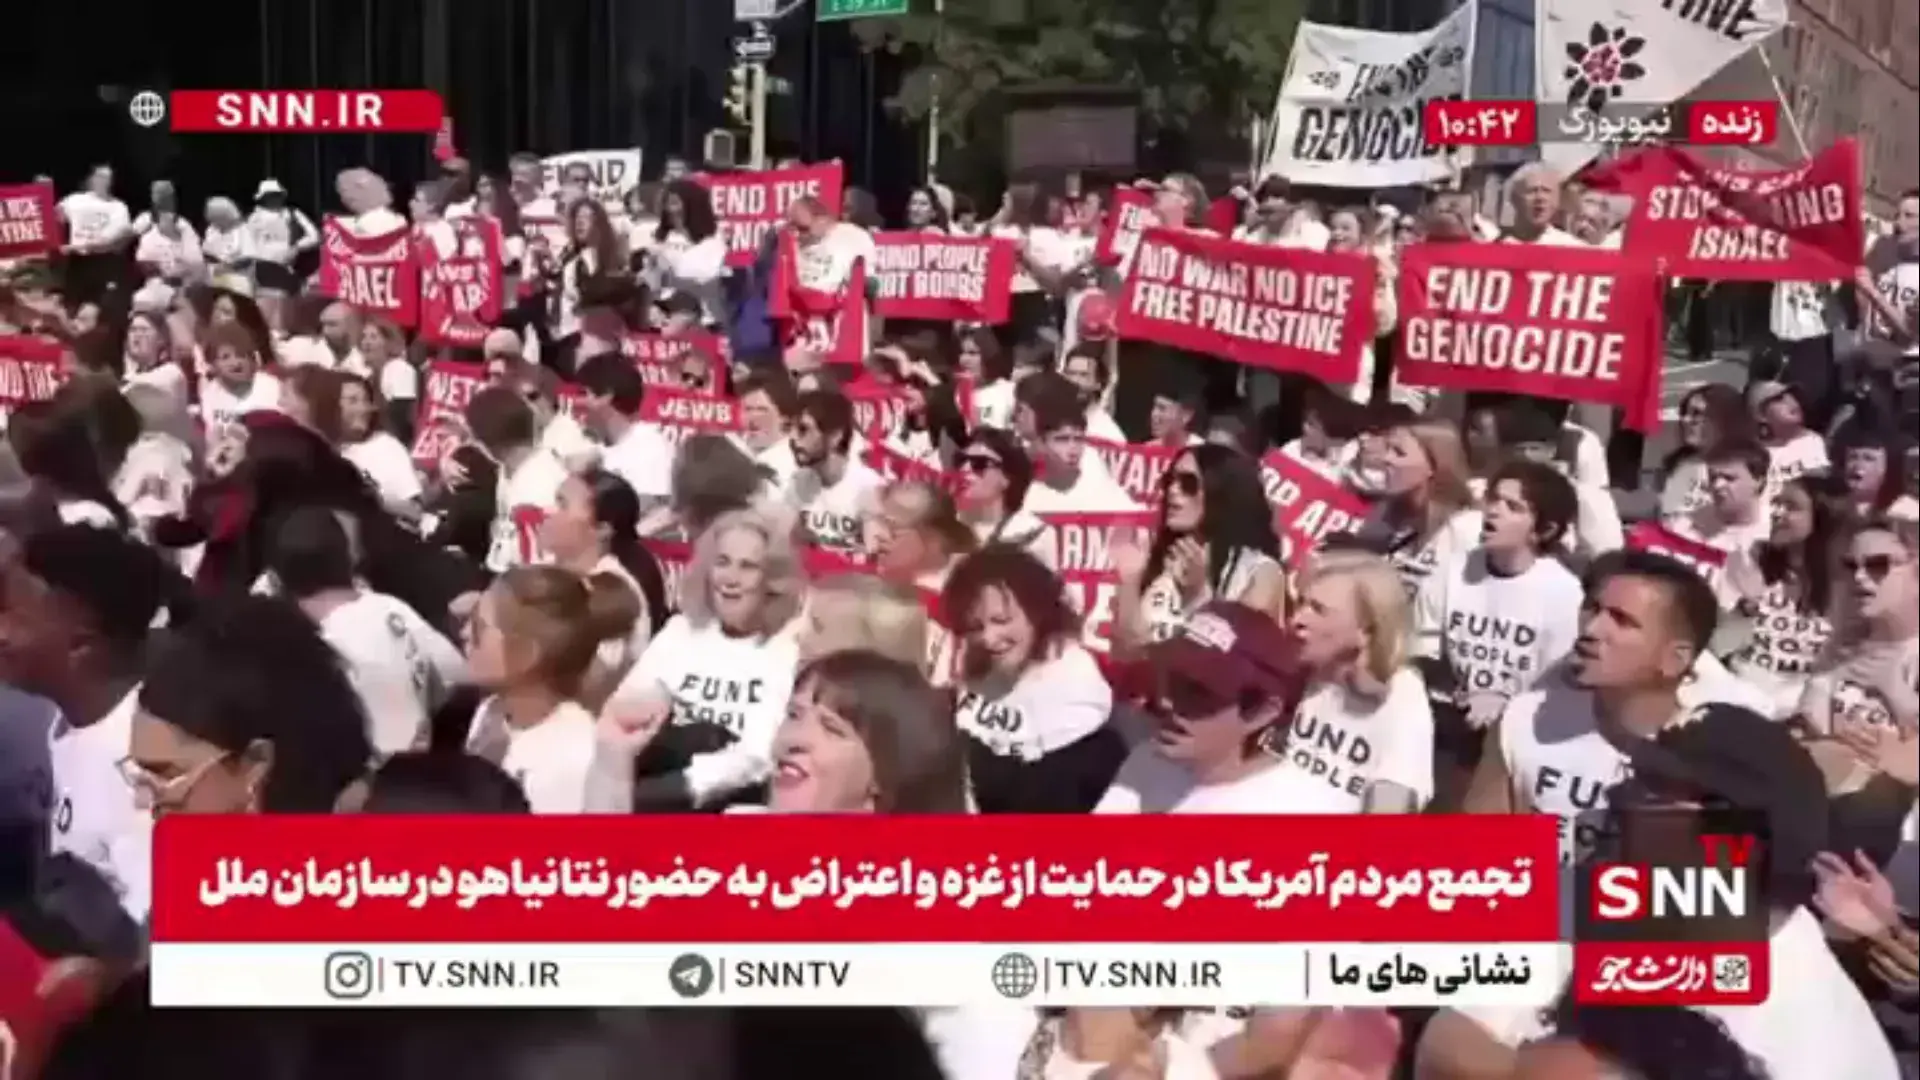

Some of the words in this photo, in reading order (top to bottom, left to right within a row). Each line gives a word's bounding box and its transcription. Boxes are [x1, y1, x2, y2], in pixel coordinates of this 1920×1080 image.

[1292, 97, 1461, 161] GENOCI
[711, 184, 766, 216] END
[1137, 243, 1179, 281] NO
[1182, 253, 1250, 298] WAR
[1253, 265, 1299, 308] NO
[1303, 272, 1354, 316] ICE
[1426, 265, 1512, 316] END
[1526, 270, 1616, 322] THE
[1130, 281, 1196, 325] FREE
[1196, 292, 1347, 356] PALESTINE
[1405, 316, 1626, 381] GENOCIDE
[1449, 610, 1536, 647] FUND
[1294, 711, 1372, 767] UND
[1292, 748, 1367, 798] OPLE
[1534, 765, 1602, 811] FU
